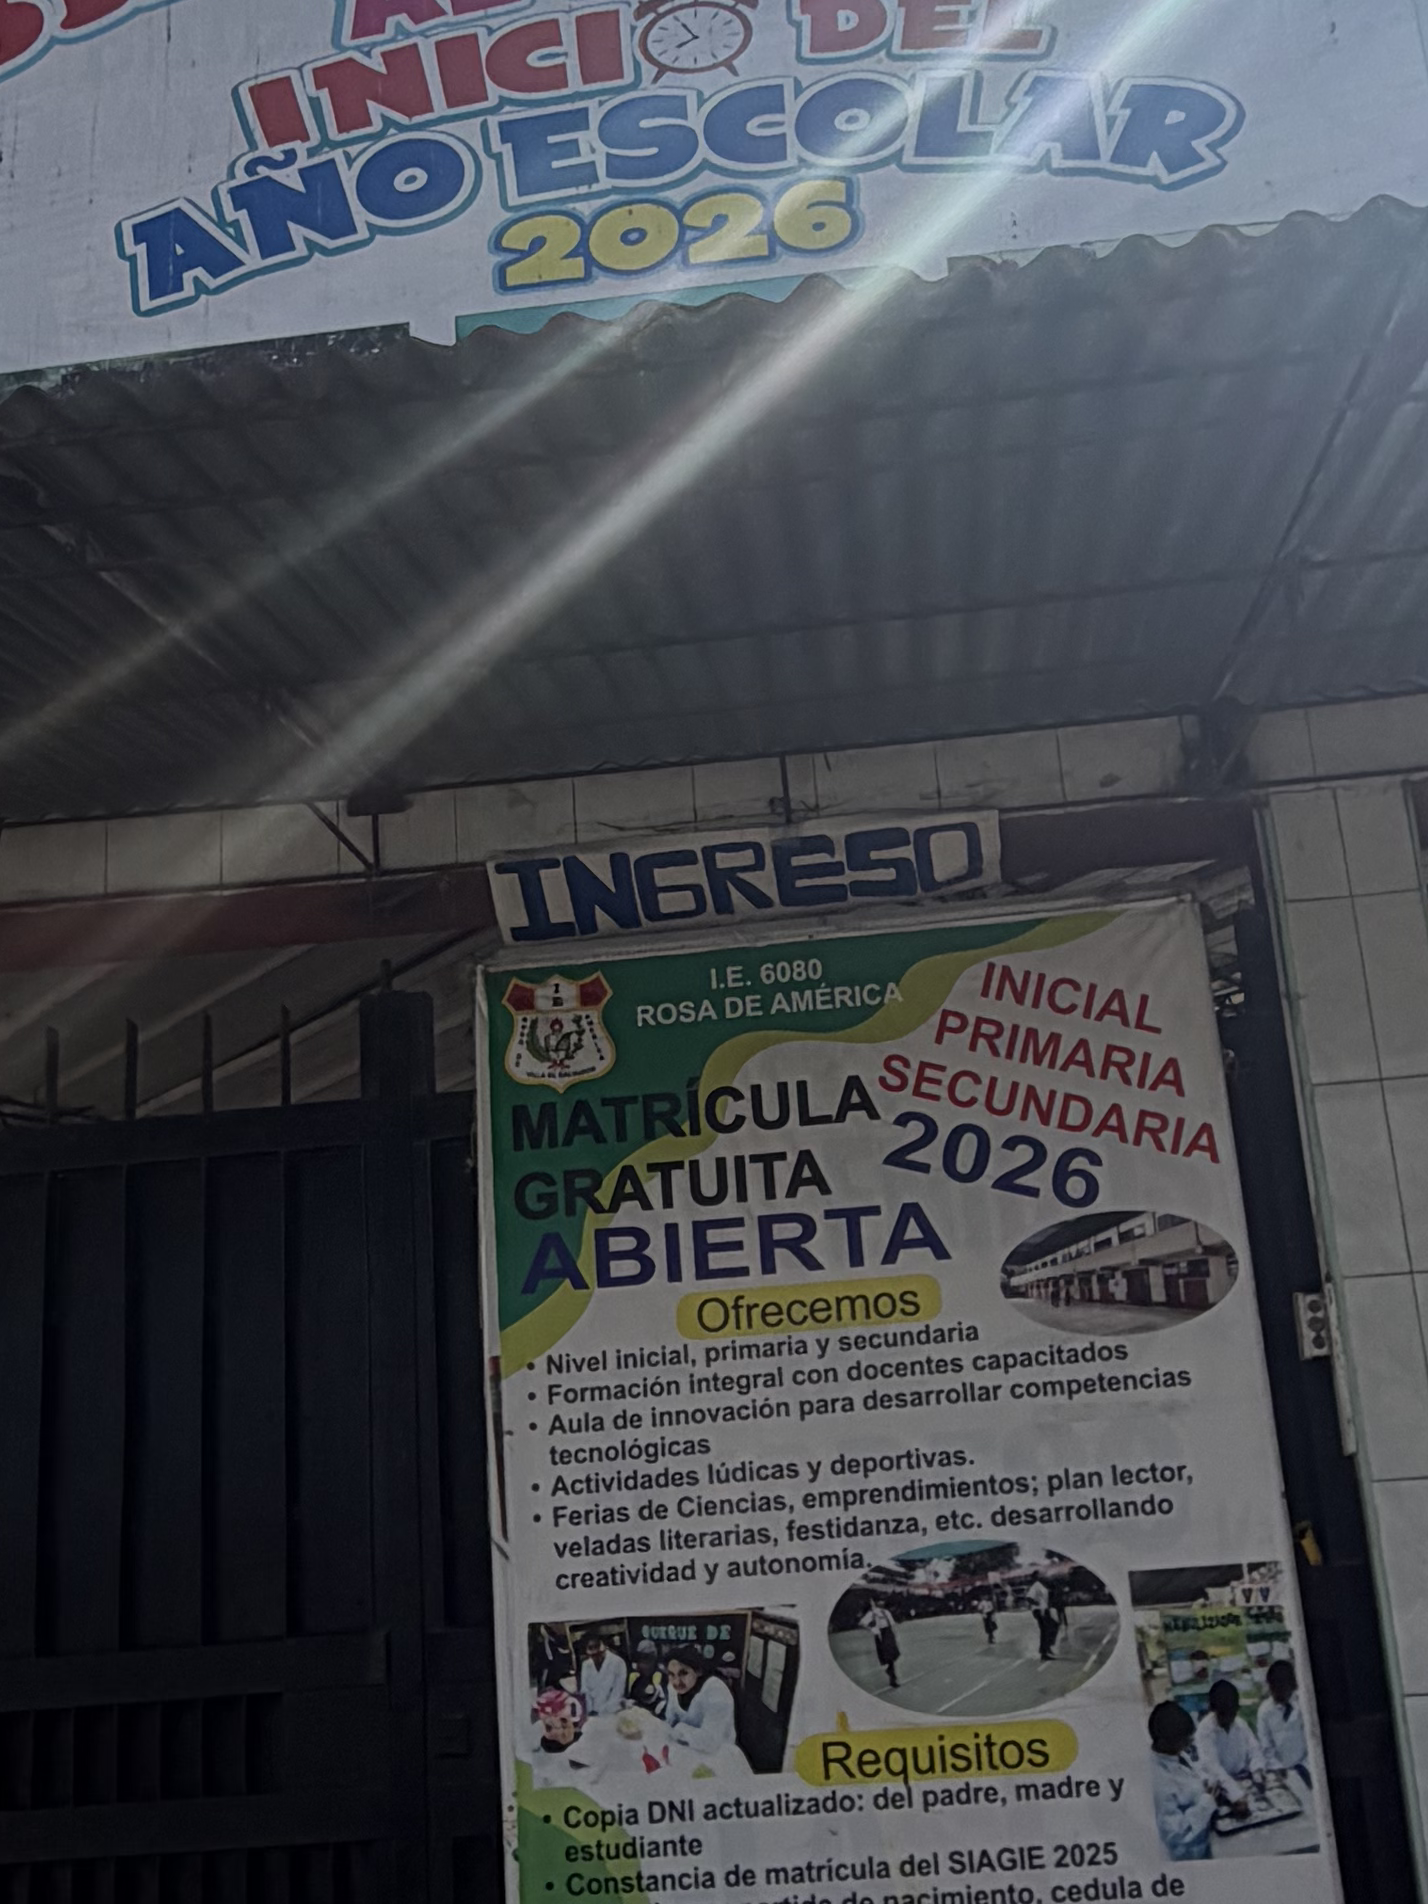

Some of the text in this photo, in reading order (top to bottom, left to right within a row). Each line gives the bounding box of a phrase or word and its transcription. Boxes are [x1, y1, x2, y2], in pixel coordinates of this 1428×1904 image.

[130, 78, 1228, 302] AÑO ESCOLAR
[502, 179, 855, 288] 2026
[494, 821, 984, 942] INGRESO
[636, 982, 903, 1027] ROSA DE AMÉRICA
[709, 959, 823, 990] I.E. 6080
[980, 962, 1162, 1035] INICIAL
[934, 1009, 1185, 1098] PRIMARIA
[511, 1075, 881, 1152] MATRÍCULA
[878, 1054, 1220, 1164] SECUNDARIA
[514, 1149, 832, 1220] GRATUITA
[882, 1111, 1103, 1208] 2026
[521, 1202, 952, 1295] ABIERTA
[697, 1290, 921, 1334] Ofrecemos
[547, 1322, 979, 1375] Nivel inicial, primaria y secundaria
[548, 1342, 1129, 1405] Formación integral con docentes capacitados
[548, 1367, 1192, 1435] Aula de innovación para desarrollar competencias
[549, 1437, 711, 1466] tecnológicas
[551, 1448, 974, 1497] Actividades lúdicas y deportivas.
[552, 1463, 1193, 1527] Ferias de Ciencias, emprendimientos; plan lector,
[554, 1495, 1174, 1558] veladas literarias, festidanza, etc. desarrollando
[555, 1547, 872, 1590] creatividad y autonomía.
[820, 1733, 1050, 1784] Requisitos
[564, 1774, 1125, 1832] Copia DNI actualizado: del padre, madre y
[565, 1835, 703, 1862] estudiante
[566, 1842, 1118, 1896] Constancia de matrícula del SIAGIE 2025
[1051, 1875, 1143, 1903] cedula
[1151, 1873, 1186, 1897] de
